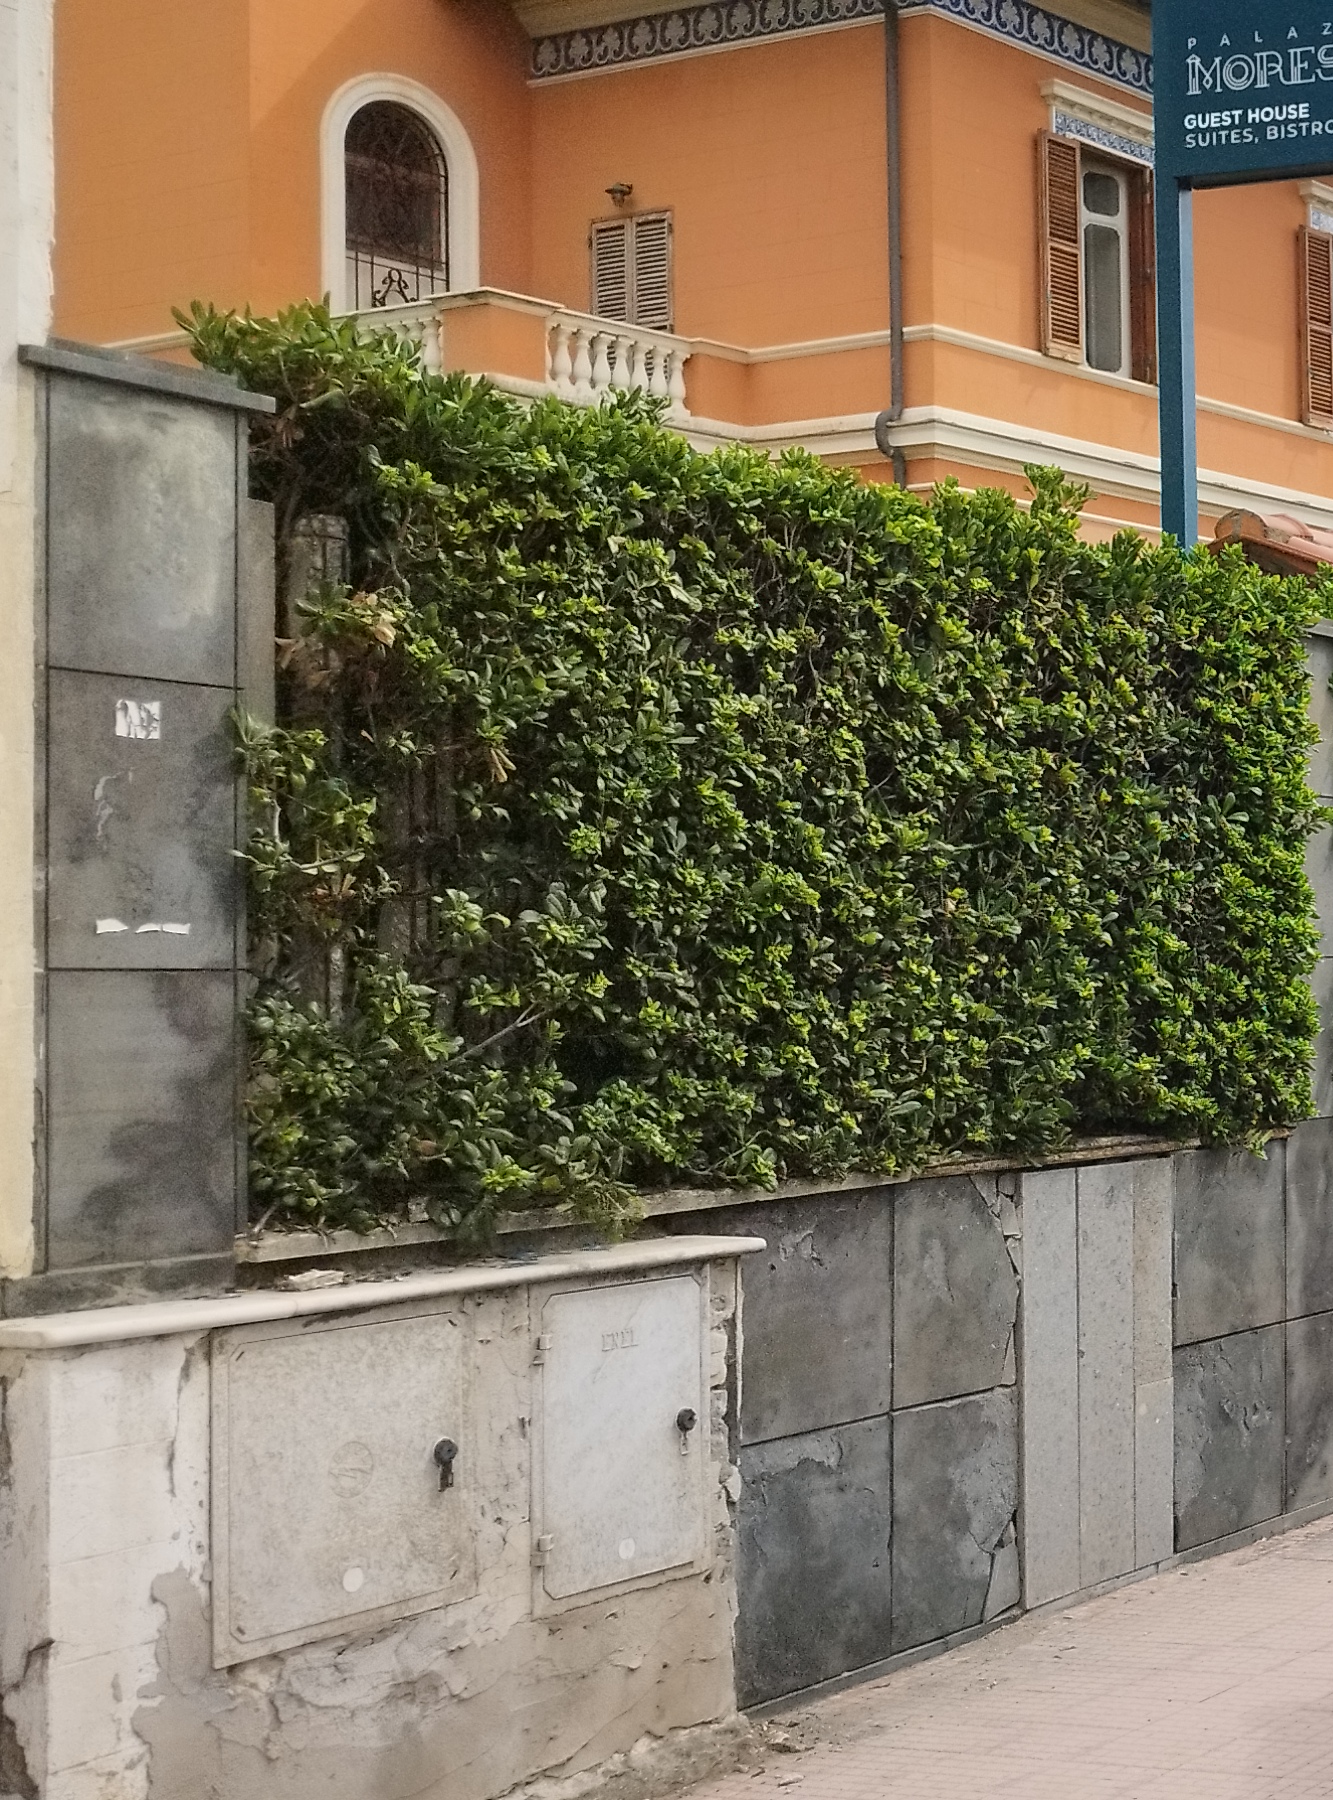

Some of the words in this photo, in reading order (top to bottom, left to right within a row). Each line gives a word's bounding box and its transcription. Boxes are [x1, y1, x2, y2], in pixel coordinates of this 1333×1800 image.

[1184, 109, 1244, 130] GUEST
[1247, 102, 1311, 124] HOUSE
[1185, 127, 1259, 149] SUITES,
